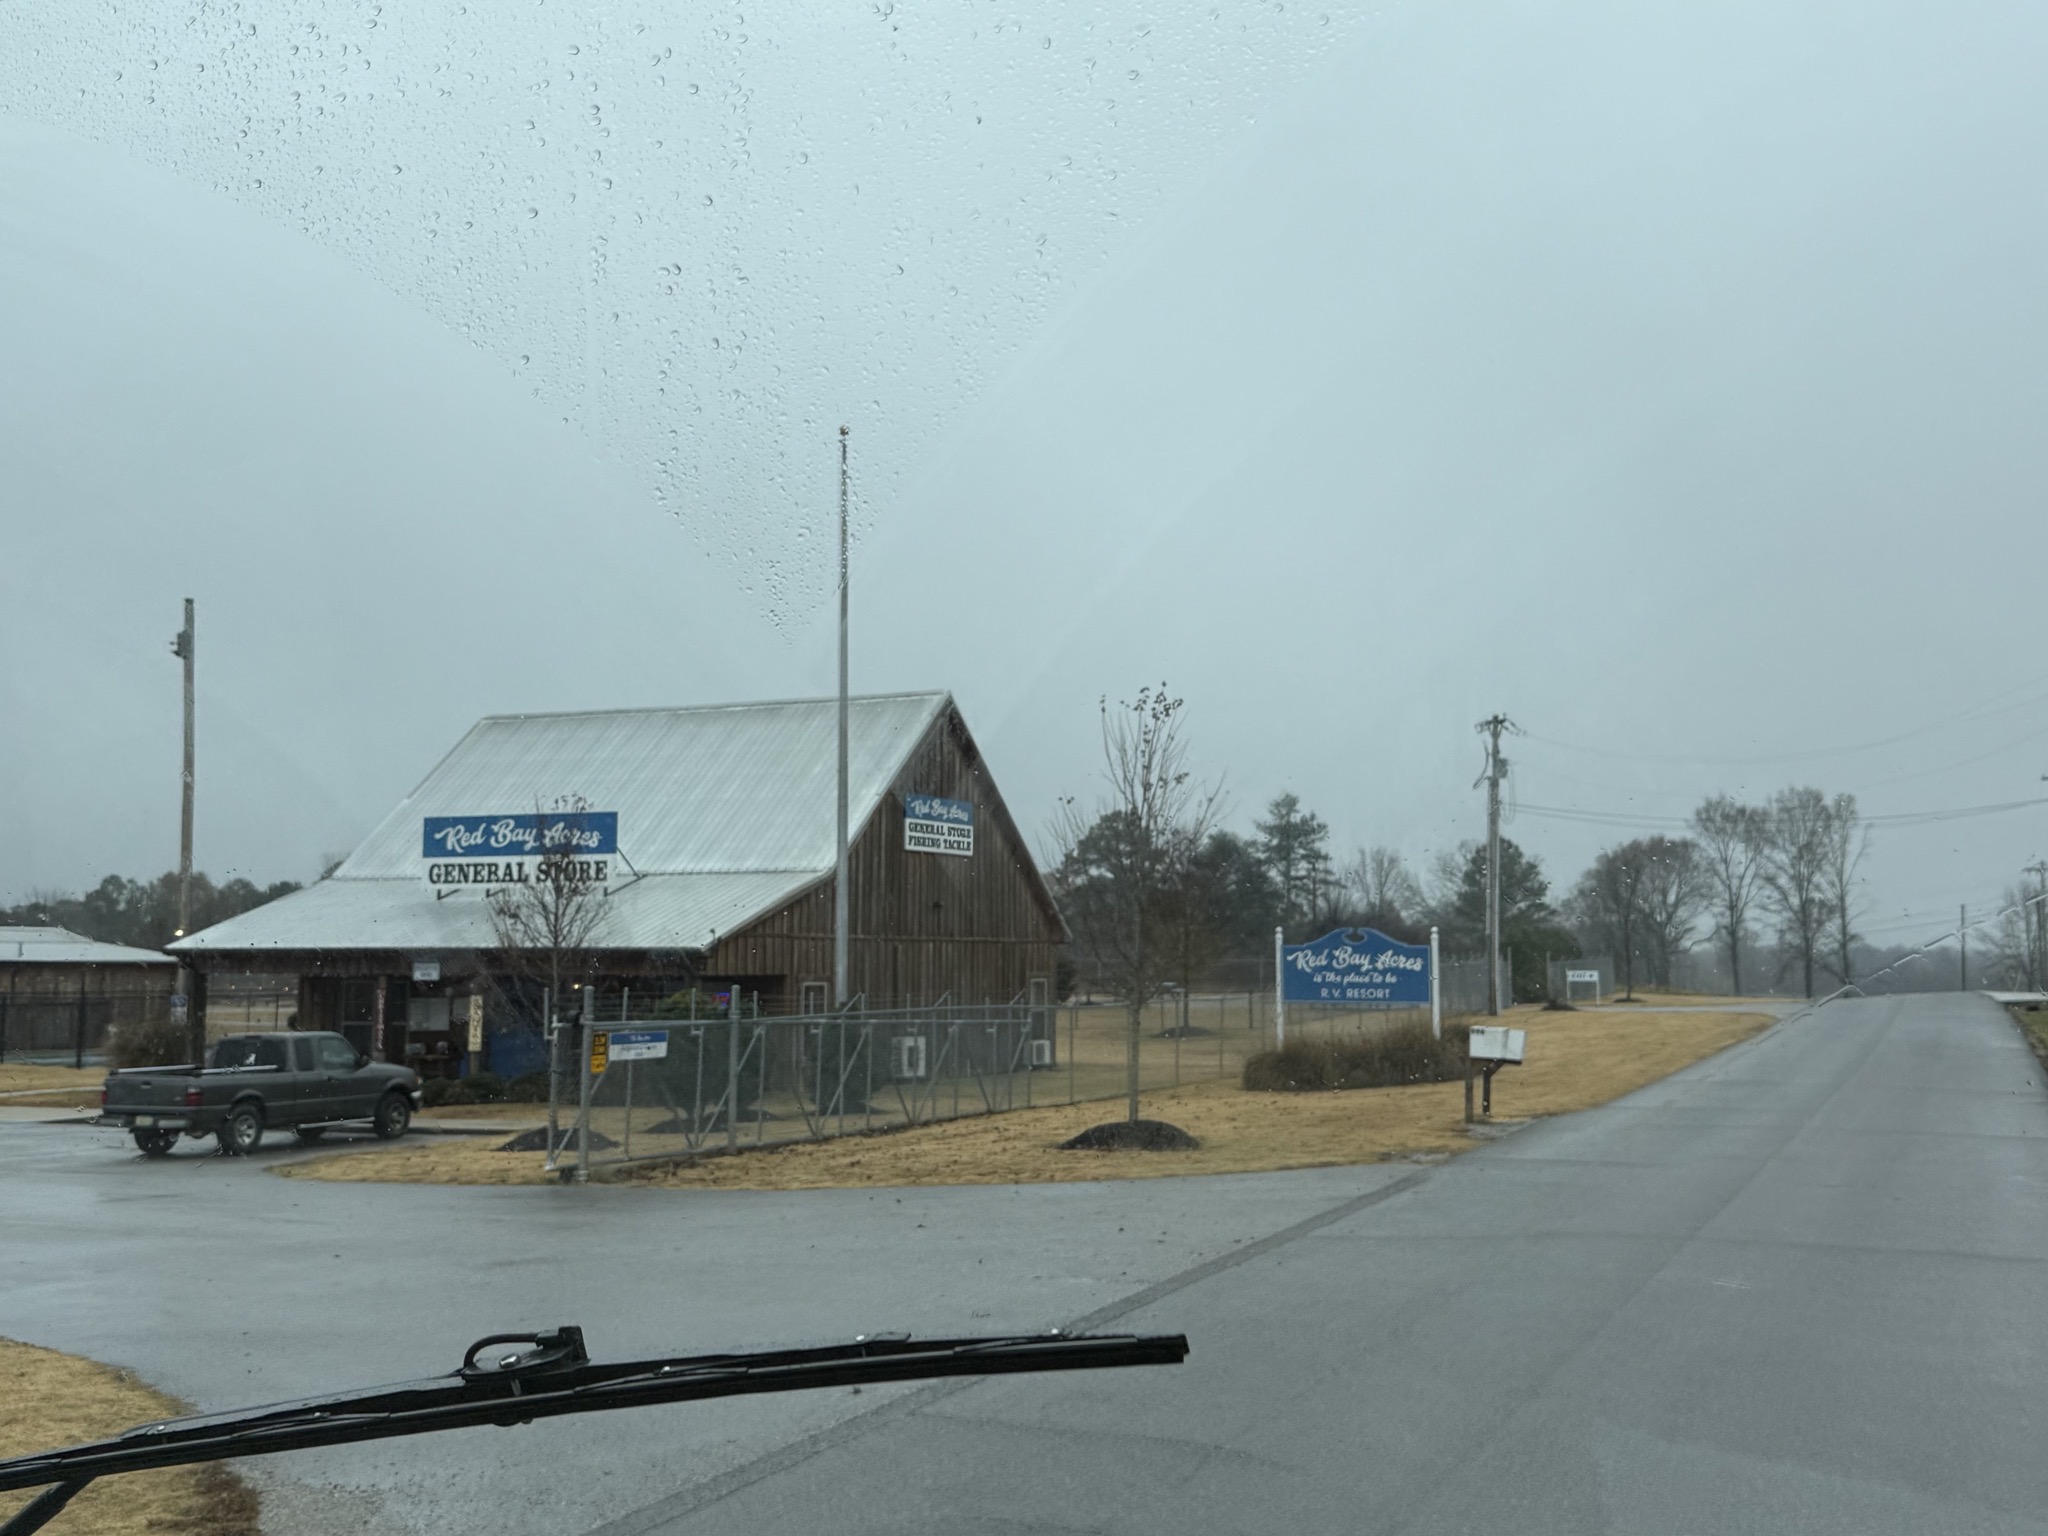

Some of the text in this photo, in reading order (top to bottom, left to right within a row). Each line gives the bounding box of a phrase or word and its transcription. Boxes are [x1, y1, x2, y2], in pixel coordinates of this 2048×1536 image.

[434, 819, 602, 853] Red Bay Acres
[908, 822, 971, 838] GENERAL STORE
[908, 835, 971, 851] FISHING TACKLE
[429, 860, 608, 884] GENERAL STORE
[1287, 946, 1423, 973] Red Bay Acres
[1313, 972, 1397, 986] is the place to be
[1346, 988, 1390, 999] RESORT
